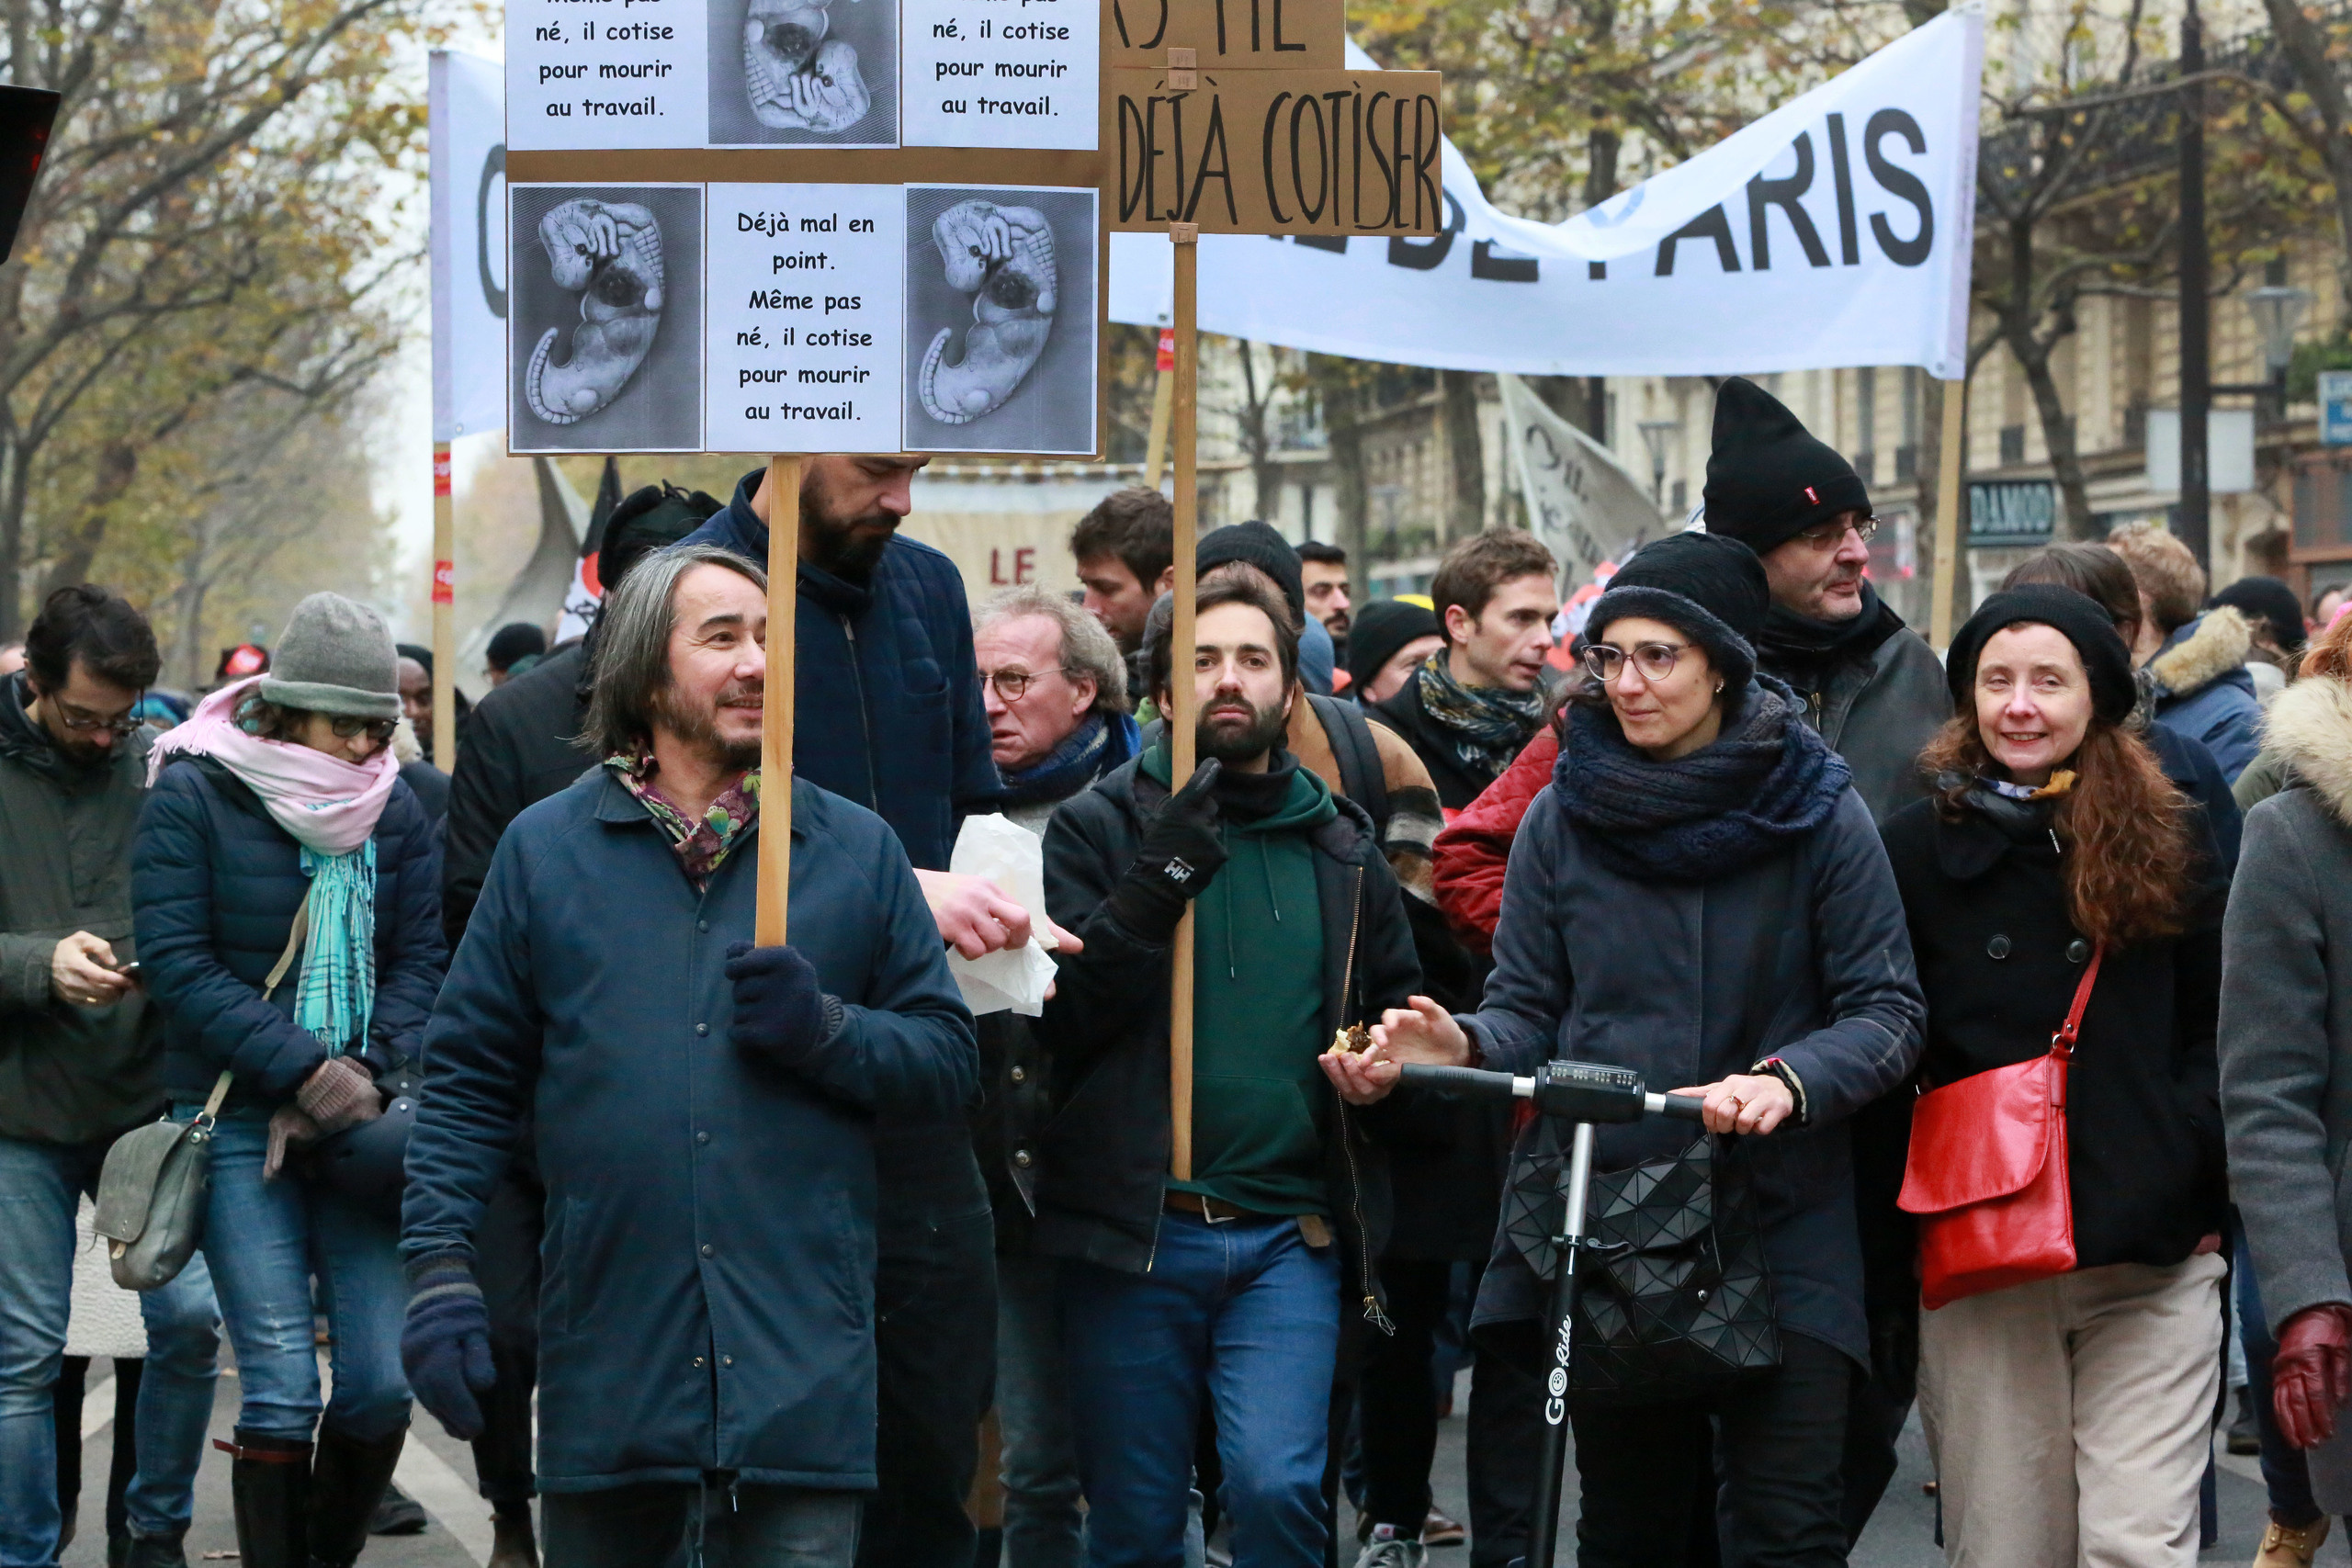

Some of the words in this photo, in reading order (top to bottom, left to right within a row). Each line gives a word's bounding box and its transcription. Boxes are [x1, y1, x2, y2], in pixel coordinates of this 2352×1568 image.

[536, 20, 569, 44] né,
[583, 20, 594, 40] il
[606, 21, 674, 40] cotise
[933, 17, 966, 41] né,
[980, 18, 991, 39] il
[1002, 21, 1069, 40] cotise
[539, 64, 588, 85] pour
[599, 59, 673, 79] mourir
[935, 62, 984, 82] pour
[995, 59, 1068, 78] mourir
[546, 103, 571, 117] au
[582, 96, 664, 117] travail.
[941, 99, 967, 114] au
[977, 96, 1058, 117] travail.
[1118, 76, 1238, 226] DÉJÀ
[738, 210, 790, 238] Déjà
[800, 212, 837, 233] mal
[848, 219, 875, 233] en
[773, 251, 835, 275] point.
[748, 288, 814, 310] Même
[824, 296, 862, 316] pas
[737, 325, 769, 349] né,
[784, 326, 795, 346] il
[806, 328, 873, 347] cotise
[739, 368, 787, 389] pour
[797, 365, 870, 384] mourir
[745, 406, 770, 420] au
[780, 400, 861, 421] travail.
[990, 547, 1035, 585] LE
